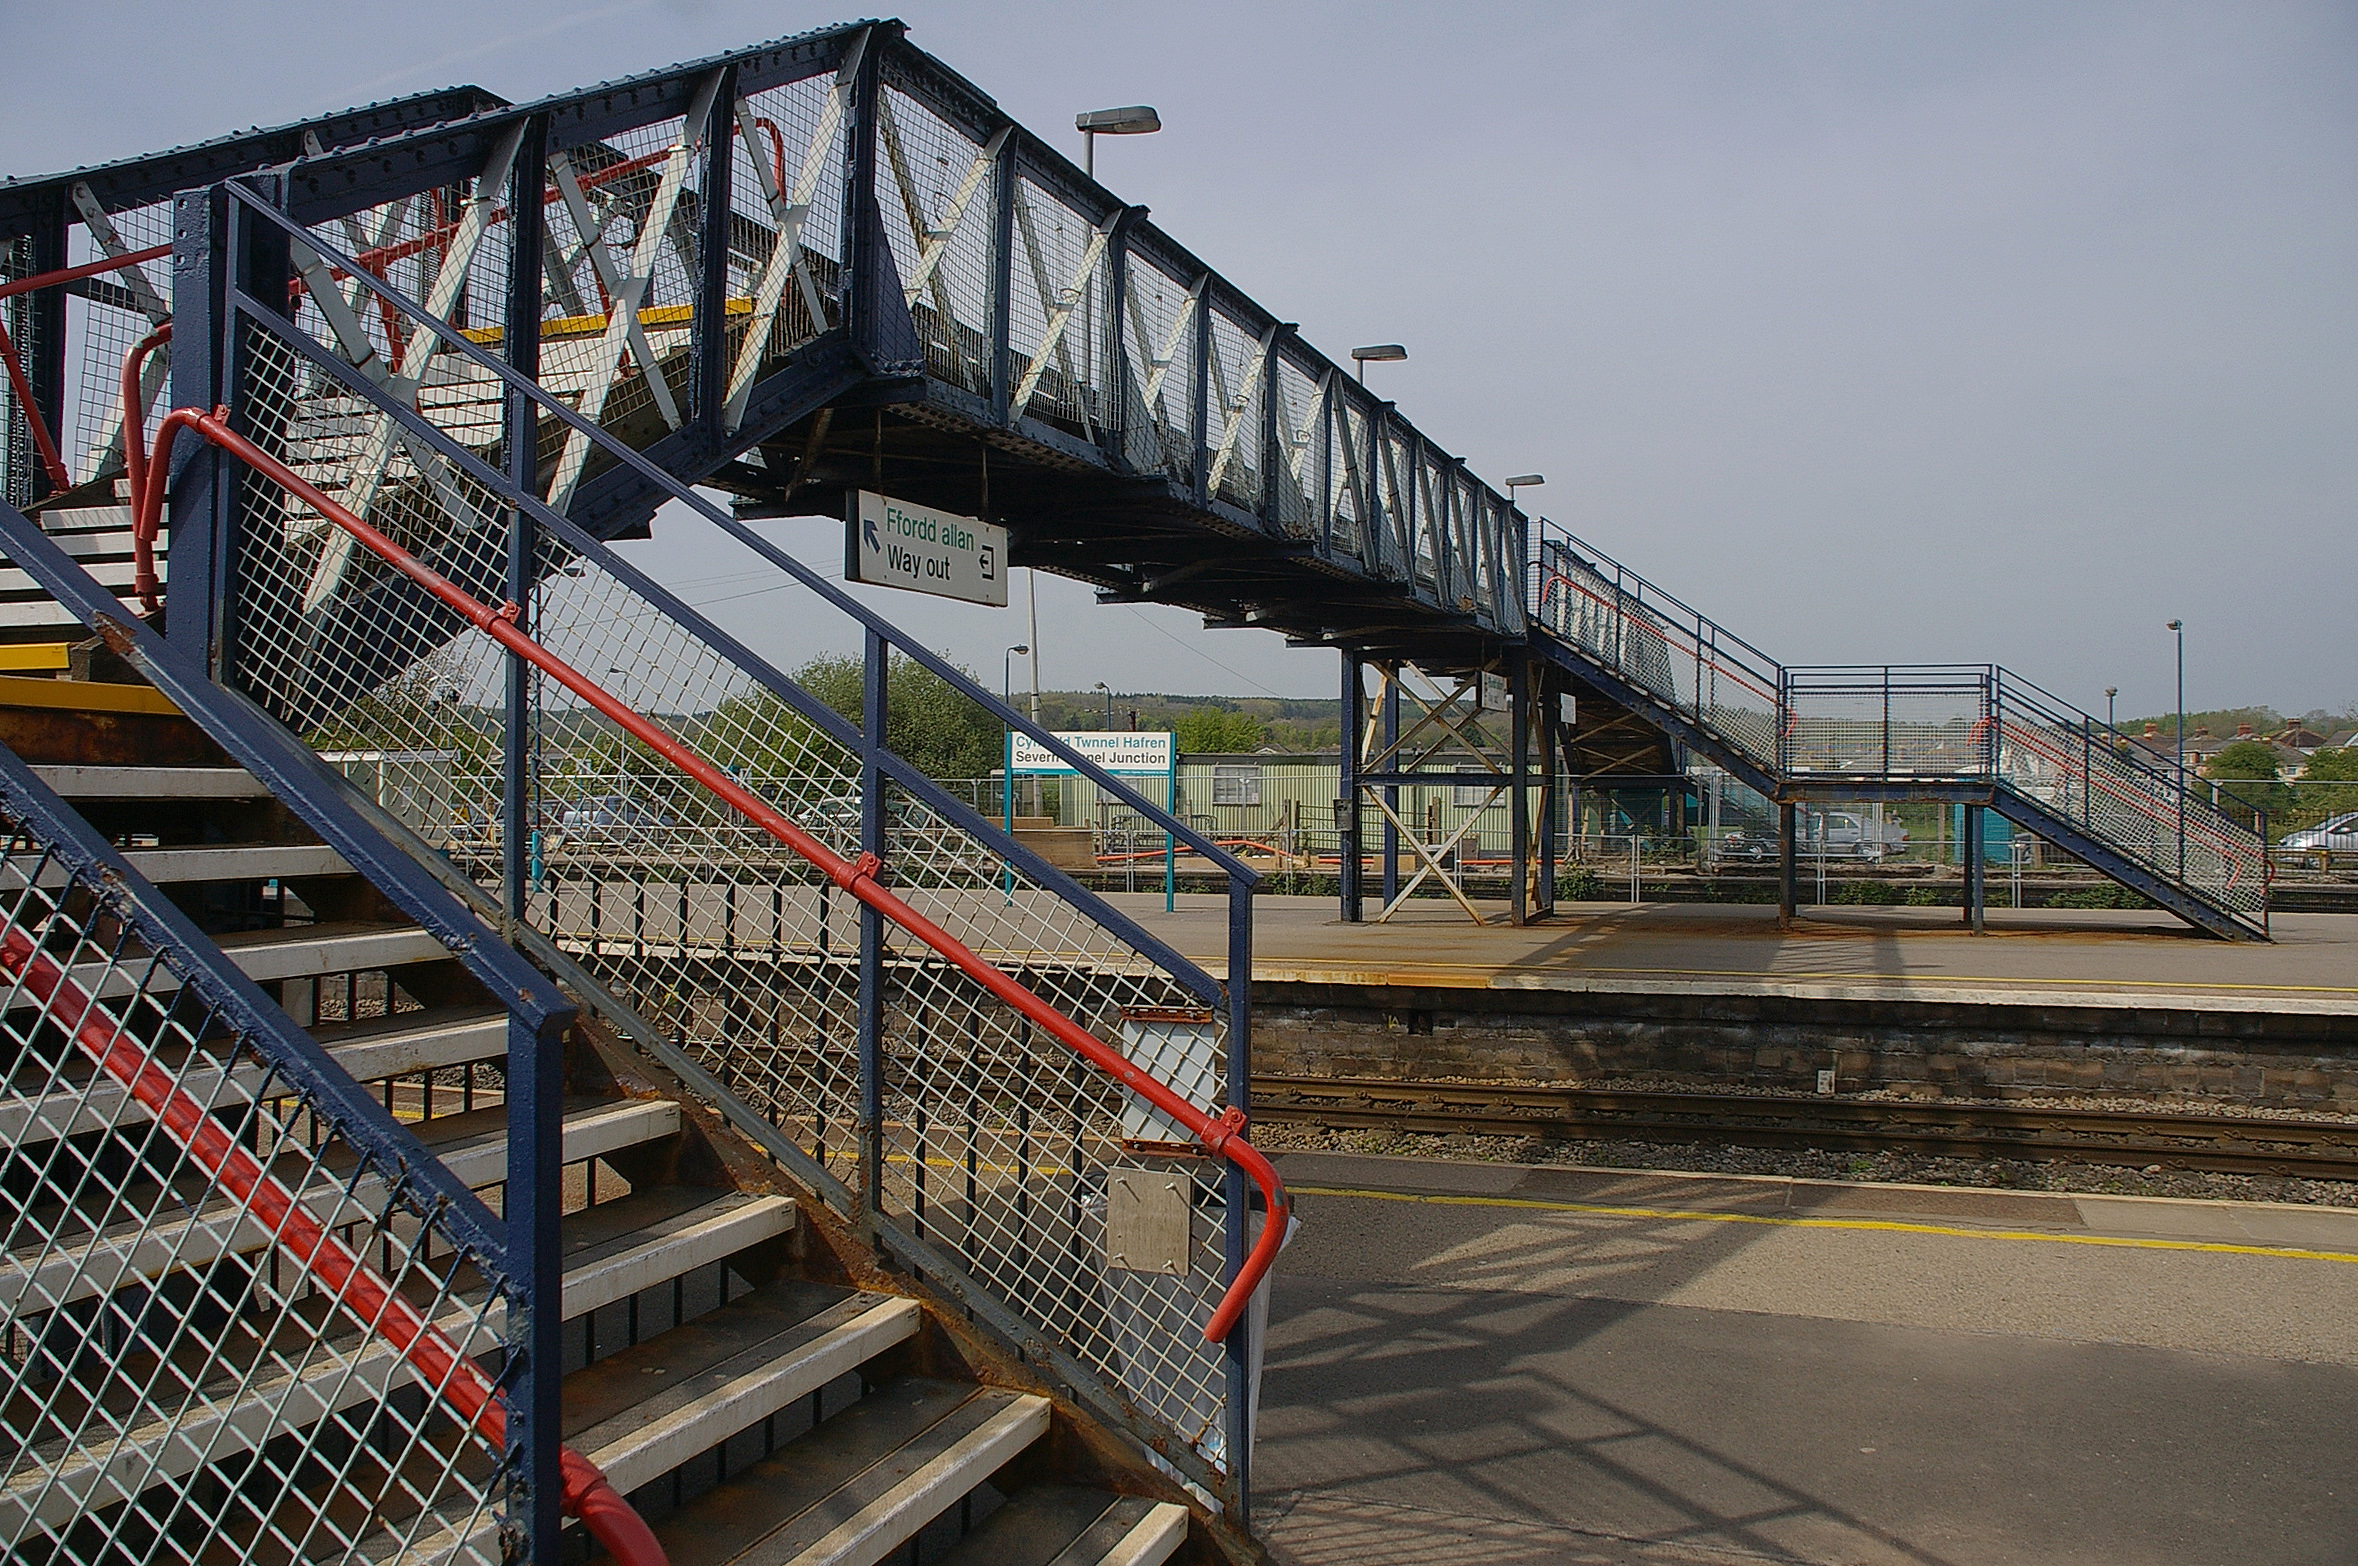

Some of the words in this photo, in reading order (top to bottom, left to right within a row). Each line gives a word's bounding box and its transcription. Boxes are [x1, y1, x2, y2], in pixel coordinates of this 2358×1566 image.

[887, 507, 936, 543] Ffordd
[941, 523, 974, 551] allan
[887, 543, 921, 579] Way
[926, 556, 951, 580] out
[1074, 736, 1119, 748] Twnnel
[1123, 736, 1166, 748] Hafren
[1016, 750, 1060, 763] Severn
[1109, 751, 1166, 764] Junction
